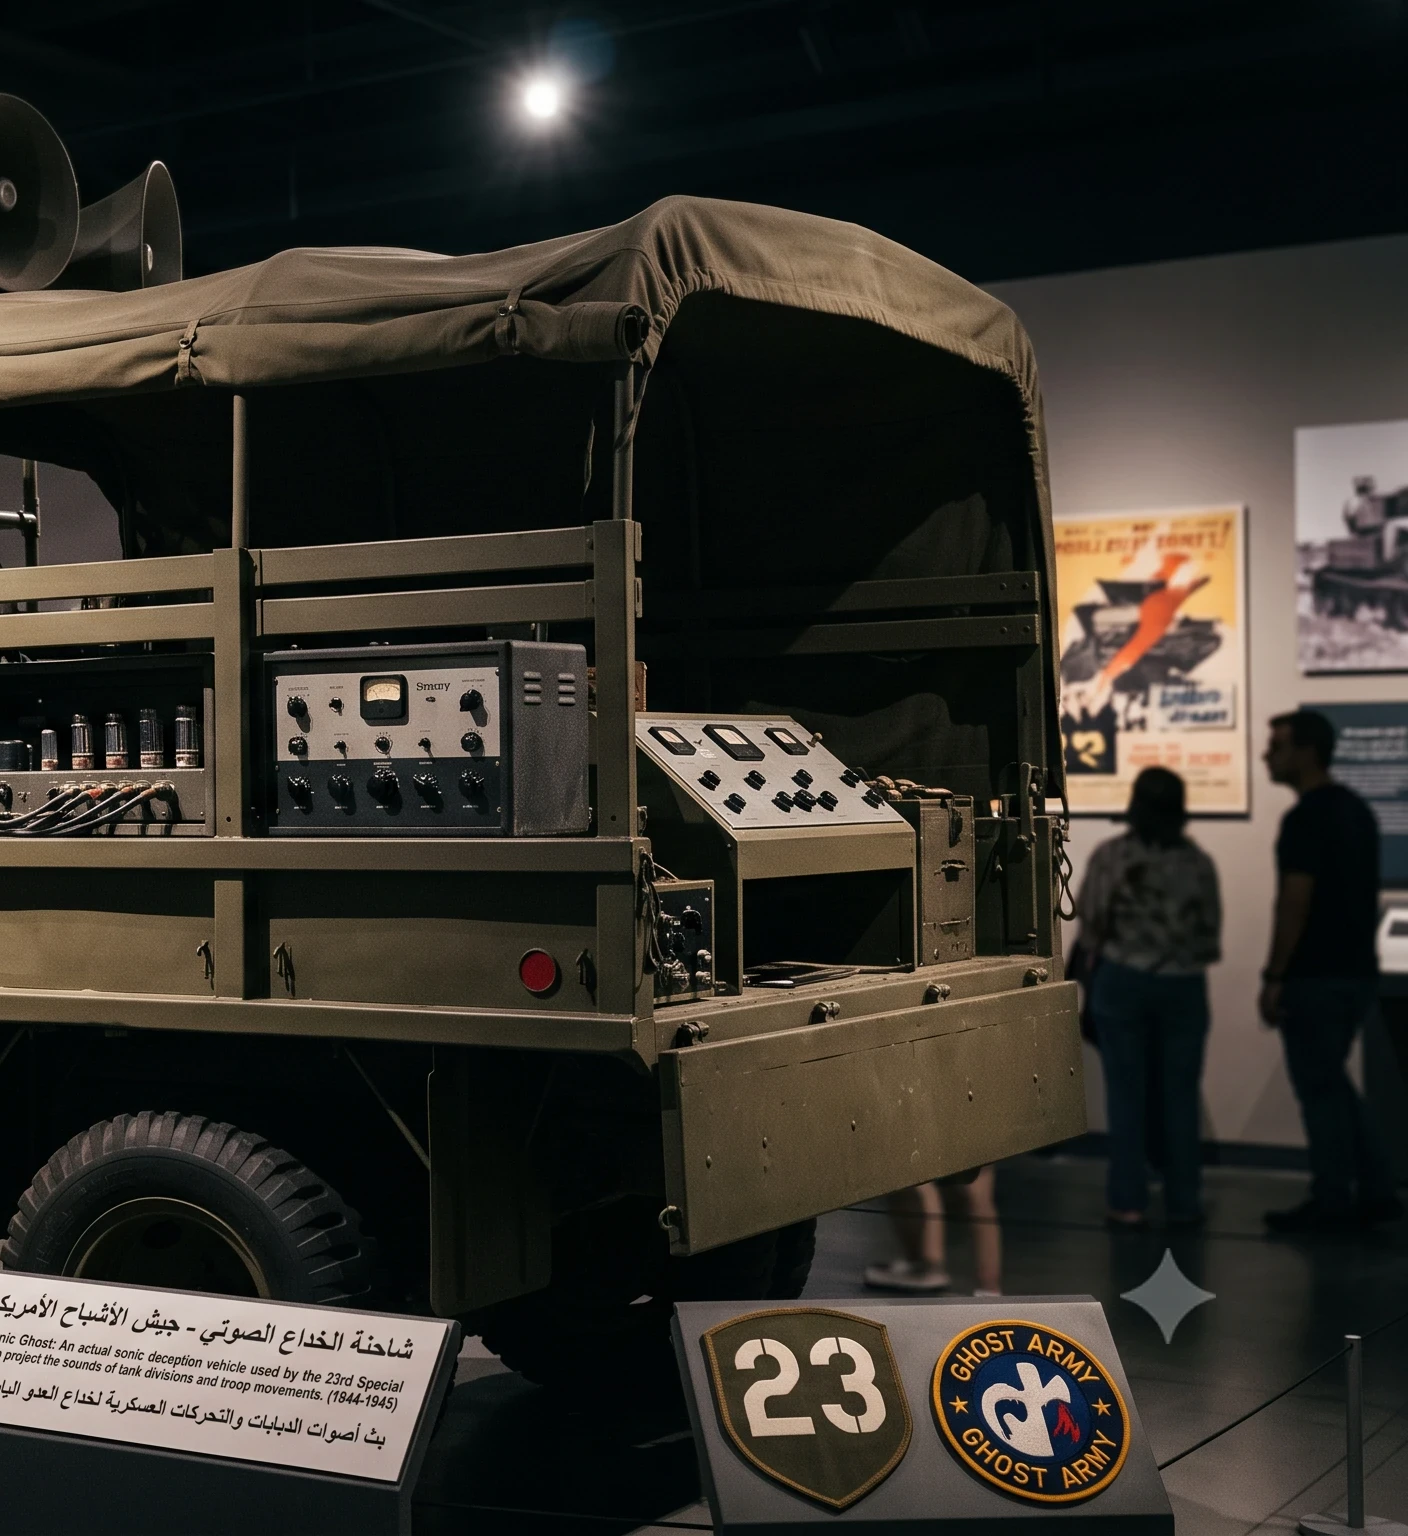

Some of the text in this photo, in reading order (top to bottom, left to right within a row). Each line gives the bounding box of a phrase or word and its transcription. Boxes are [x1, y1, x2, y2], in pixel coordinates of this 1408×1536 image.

[59, 1300, 130, 1329] الأشباح
[132, 1308, 181, 1337] جيش
[200, 1318, 277, 1346] الصوتي
[279, 1327, 345, 1356] الخداع
[350, 1330, 414, 1360] شاحنة
[20, 1335, 56, 1349] Ghost:
[59, 1340, 74, 1351] An
[78, 1344, 112, 1356] actual
[114, 1349, 144, 1360] sonic
[148, 1351, 202, 1368] deception
[208, 1360, 246, 1373] vehicle
[251, 1366, 280, 1377] used
[283, 1367, 299, 1382] by
[303, 1370, 321, 1382] the
[325, 1372, 354, 1386] 23rd
[357, 1376, 404, 1392] Special
[950, 1330, 1100, 1384] GHOST ARMY
[3, 1351, 41, 1364] project
[43, 1355, 61, 1367] the
[62, 1358, 102, 1371] sounds
[104, 1363, 118, 1374] of
[119, 1364, 142, 1376] tank
[145, 1367, 193, 1383] divisions
[197, 1376, 218, 1386] and
[221, 1378, 251, 1393] troop
[254, 1384, 323, 1401] movements.
[327, 1390, 398, 1413] (1844-1945)
[22, 1385, 59, 1402] العدو
[734, 1337, 887, 1437] 23
[60, 1388, 103, 1410] لخداع
[106, 1390, 167, 1415] العسكرية
[170, 1403, 244, 1431] والتحركات
[248, 1414, 303, 1436] الدبابات
[307, 1422, 362, 1443] أصوات
[364, 1427, 386, 1450] بث
[962, 1427, 1118, 1490] GHOST ARMY
